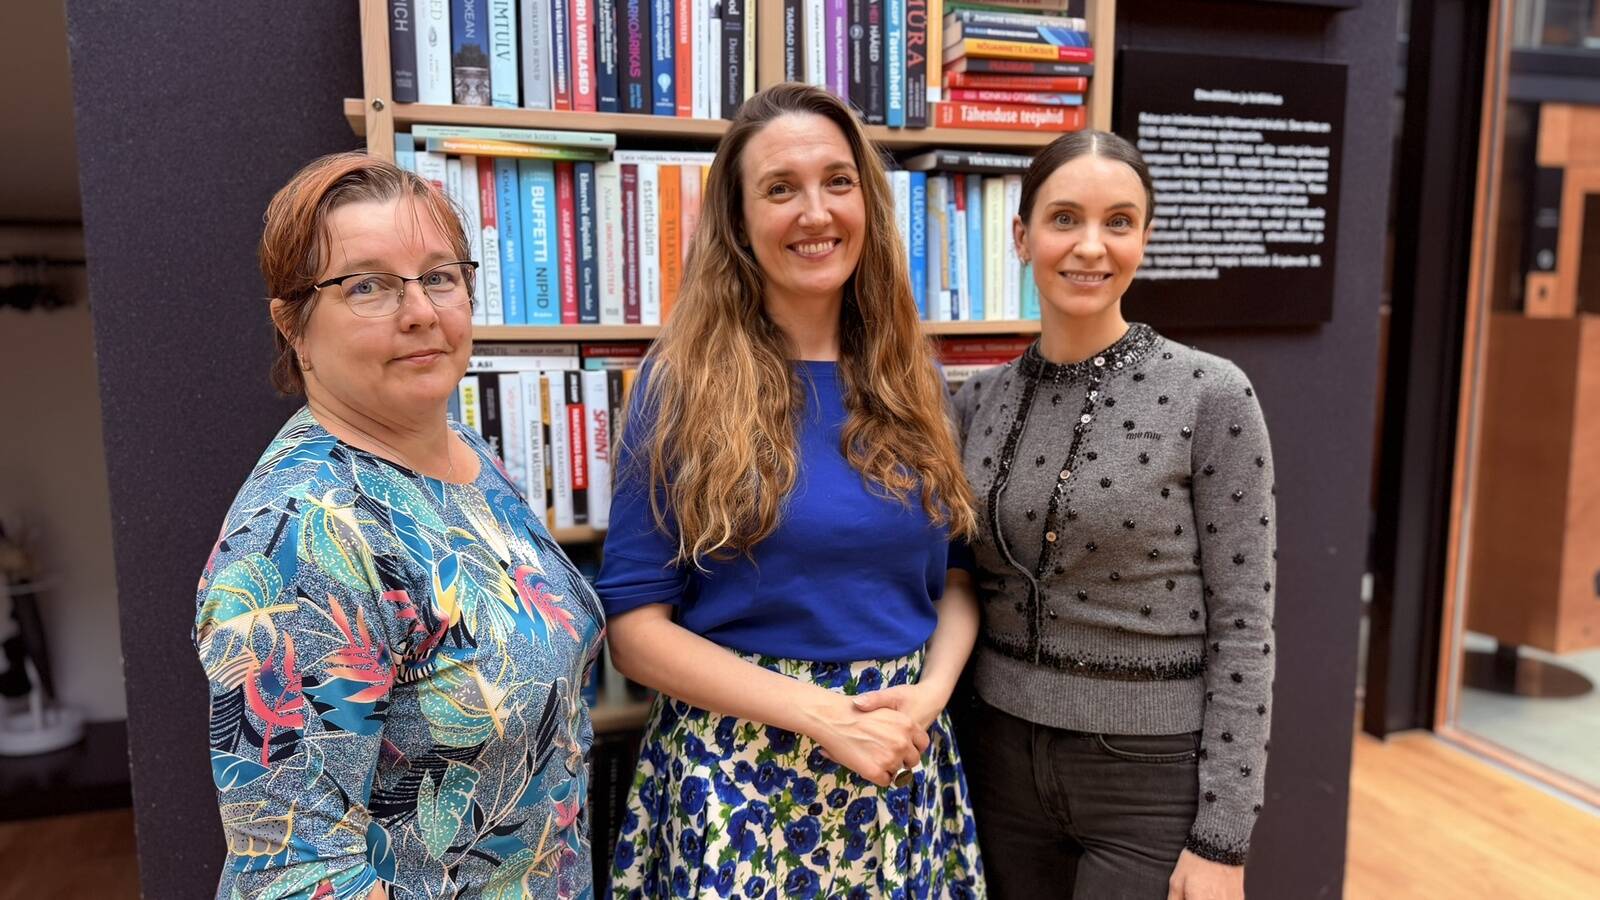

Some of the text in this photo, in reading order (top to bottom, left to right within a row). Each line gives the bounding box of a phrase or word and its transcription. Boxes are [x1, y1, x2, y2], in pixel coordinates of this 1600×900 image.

[394, 0, 409, 31] ICH
[907, 0, 926, 68] ÜRA
[576, 23, 590, 95] VAENLASED
[728, 37, 739, 64] David
[889, 29, 901, 110] Taustahelid
[960, 105, 1064, 127] Tähenduse teejuhid
[531, 186, 549, 309] BUFFETTI NIPID
[642, 180, 656, 257] essentsialism
[485, 238, 500, 309] MEELE AEG
[593, 409, 608, 463] SPRINT
